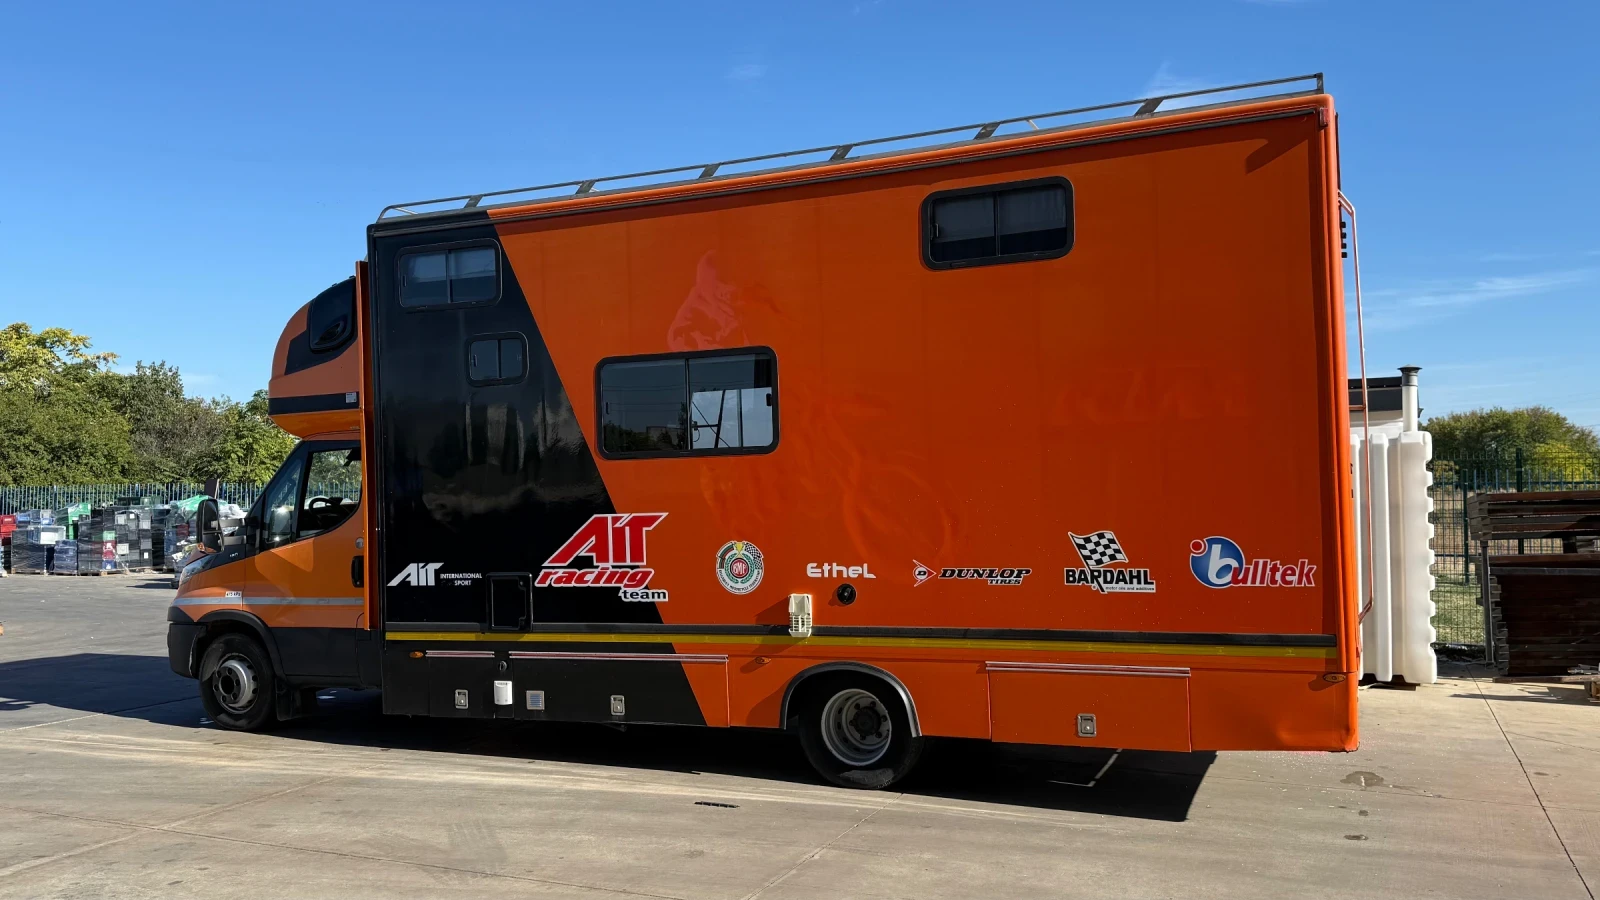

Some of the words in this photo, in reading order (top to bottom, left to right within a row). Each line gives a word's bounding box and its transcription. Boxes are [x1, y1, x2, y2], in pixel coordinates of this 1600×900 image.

[534, 566, 655, 589] racing
[939, 568, 1032, 579] DUNLOP
[1065, 568, 1155, 591] BARDAHL
[621, 589, 667, 600] team
